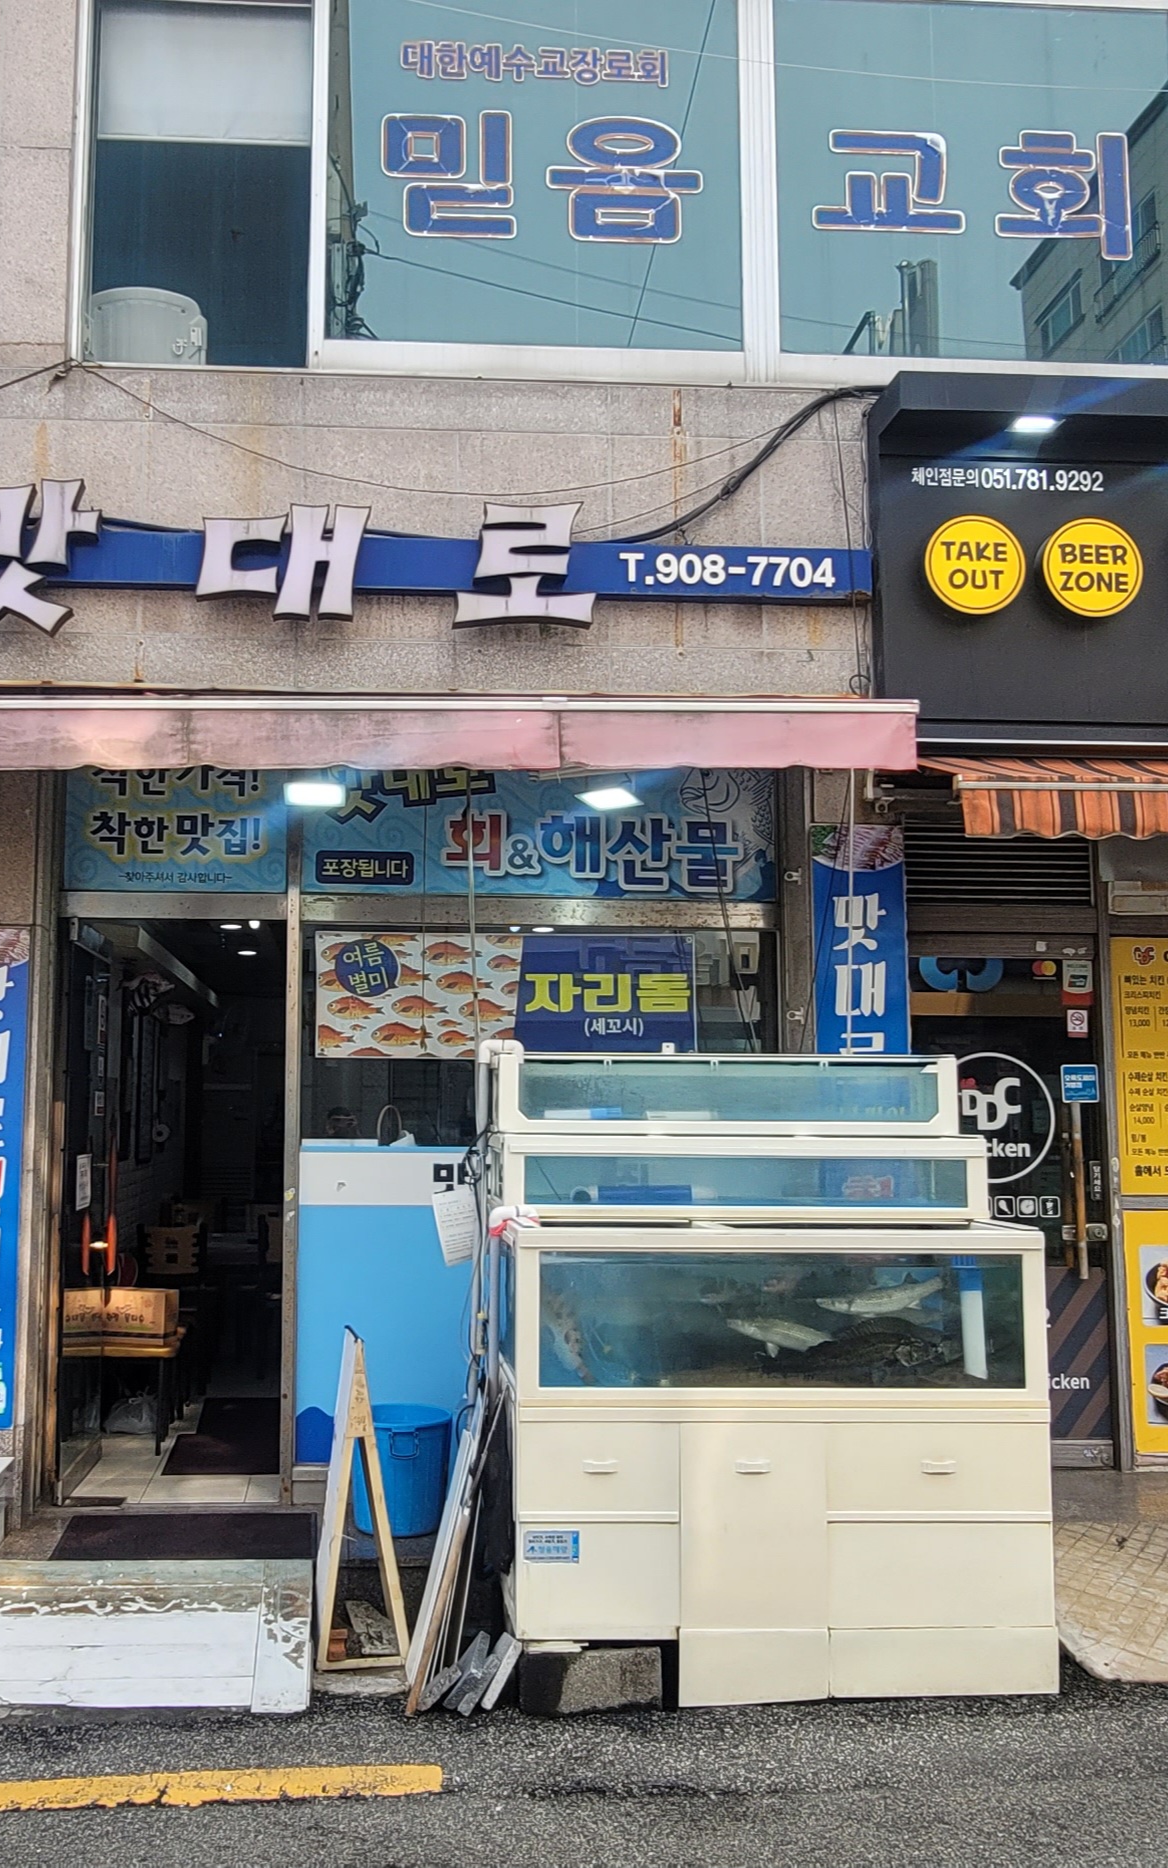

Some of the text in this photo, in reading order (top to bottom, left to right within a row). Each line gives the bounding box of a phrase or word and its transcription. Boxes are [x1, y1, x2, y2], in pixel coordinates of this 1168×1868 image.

[400, 39, 670, 88] 대한예수교장로회
[381, 110, 1134, 261] 믿음 교회
[911, 466, 1104, 492] 체인점문의 051.781.9292
[940, 540, 1008, 563] TAKE
[1057, 542, 1128, 567] BEER
[618, 550, 836, 590] T.908-7704
[948, 568, 1005, 590] OUT
[1059, 571, 1129, 594] ZONE
[89, 810, 262, 857] 착한 맛집!
[321, 858, 409, 879] 포장됩니다
[342, 941, 385, 968] 여름
[347, 970, 390, 996] 별미
[524, 973, 692, 1014] 자리돔
[583, 1017, 645, 1038] (세꼬시)
[1129, 1019, 1151, 1028] 13,000
